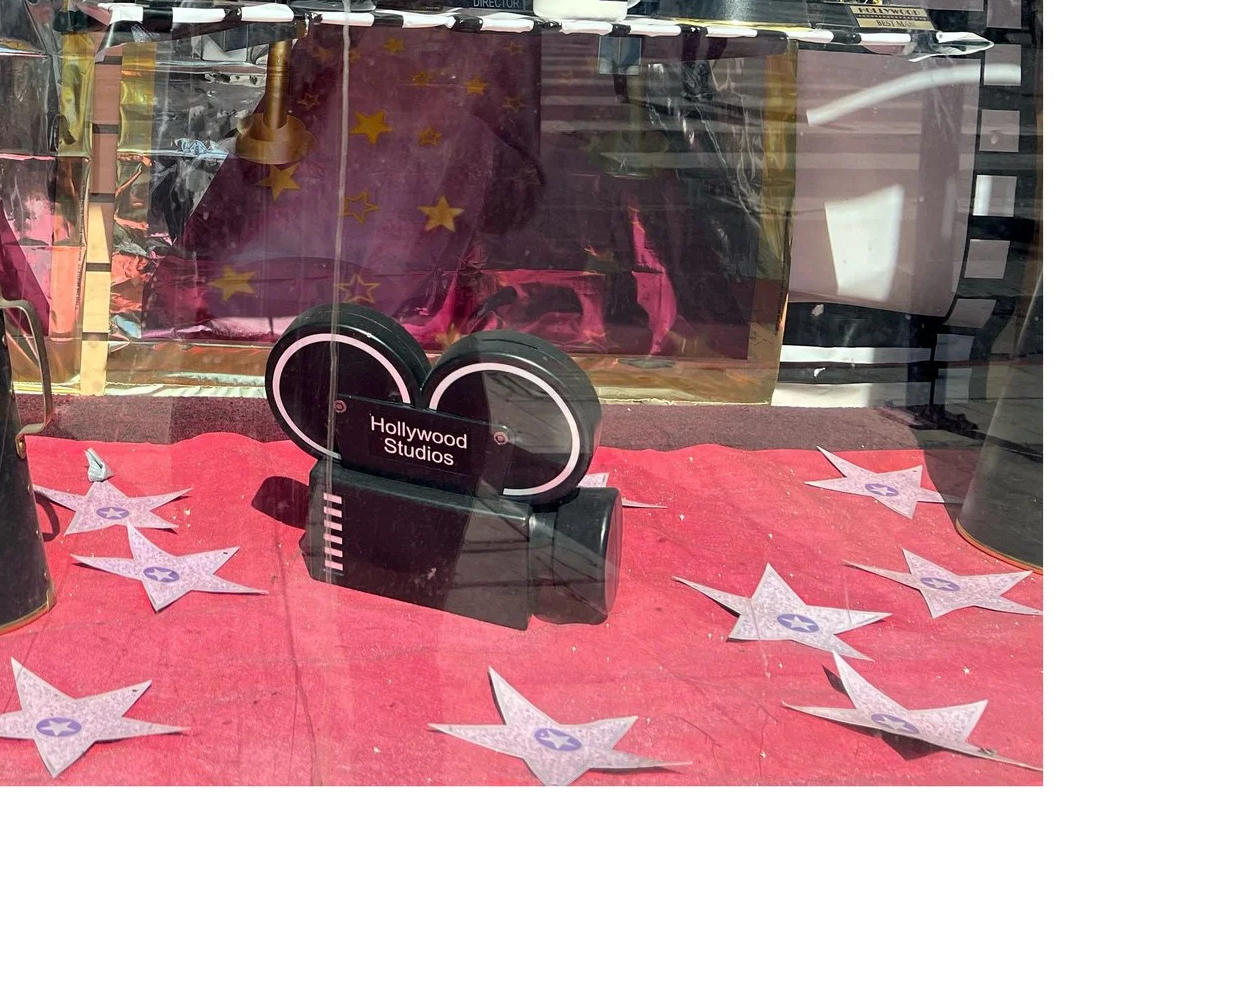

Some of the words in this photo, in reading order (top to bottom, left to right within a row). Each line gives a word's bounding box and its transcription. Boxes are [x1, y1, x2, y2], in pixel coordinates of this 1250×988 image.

[858, 7, 921, 16] HOLLYWOOD
[876, 19, 895, 27] BEST
[896, 20, 915, 28] MAN
[371, 415, 467, 449] Hollywood
[384, 437, 454, 466] Studios
